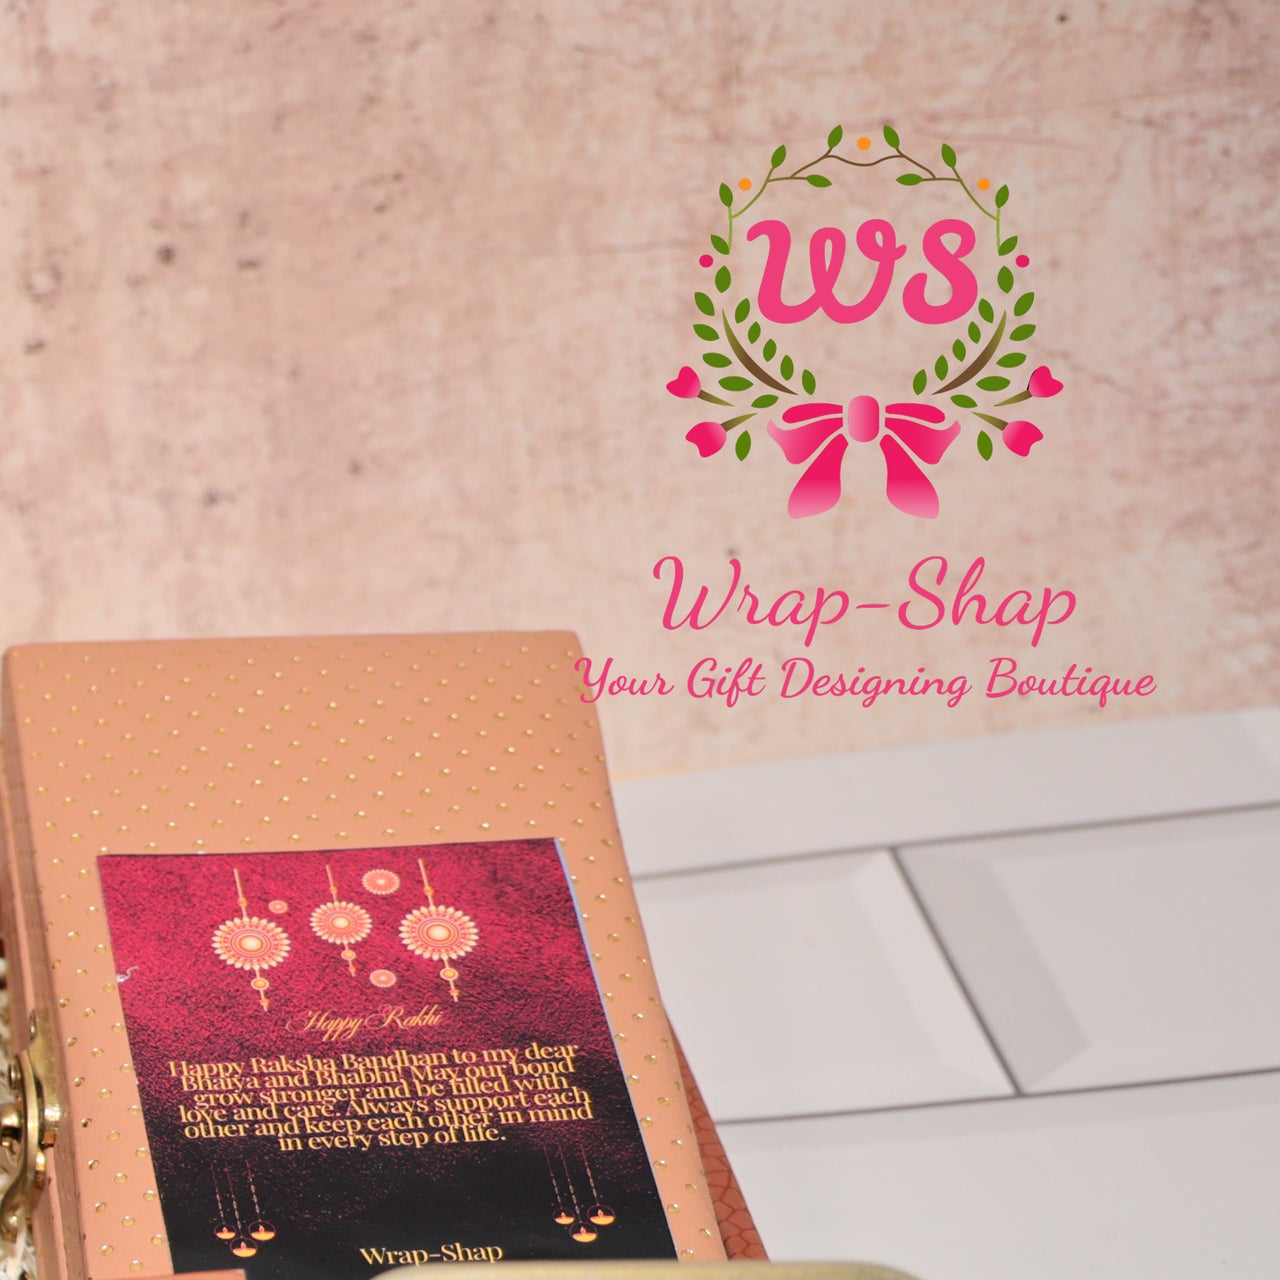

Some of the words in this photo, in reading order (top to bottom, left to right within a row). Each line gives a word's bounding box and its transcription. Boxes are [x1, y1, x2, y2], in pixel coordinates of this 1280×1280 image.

[286, 1010, 363, 1041] Happy
[365, 1005, 442, 1029] Rakhi
[169, 1061, 244, 1079] Happy
[251, 1054, 337, 1074] Raksha
[341, 1050, 448, 1070] Bandhan
[452, 1049, 477, 1066] to
[483, 1049, 518, 1066] my
[524, 1042, 579, 1060] dear
[181, 1074, 259, 1092] Bhaiya
[260, 1070, 310, 1088] and
[410, 1065, 459, 1083] May
[465, 1065, 507, 1079] our
[510, 1056, 575, 1076] bond
[179, 1105, 228, 1124] love
[233, 1102, 278, 1120] and
[284, 1104, 341, 1119] care.
[346, 1098, 429, 1117] Always
[434, 1092, 530, 1113] support
[534, 1086, 592, 1105] each
[194, 1092, 254, 1110] grow
[260, 1088, 360, 1106] stronger
[366, 1079, 411, 1099] and
[413, 1079, 445, 1097] be
[450, 1075, 510, 1095] filled
[514, 1073, 569, 1091] with
[184, 1122, 249, 1139] other
[255, 1117, 300, 1136] and
[304, 1116, 361, 1140] keep
[367, 1112, 423, 1131] each
[428, 1110, 493, 1128] other
[499, 1106, 522, 1124] in
[529, 1102, 594, 1121] mind
[278, 1133, 303, 1151] in
[308, 1133, 372, 1151] every
[379, 1130, 429, 1148] step
[434, 1125, 460, 1143] of
[464, 1124, 506, 1142] life.
[360, 1243, 503, 1266] Wrap-Shap
